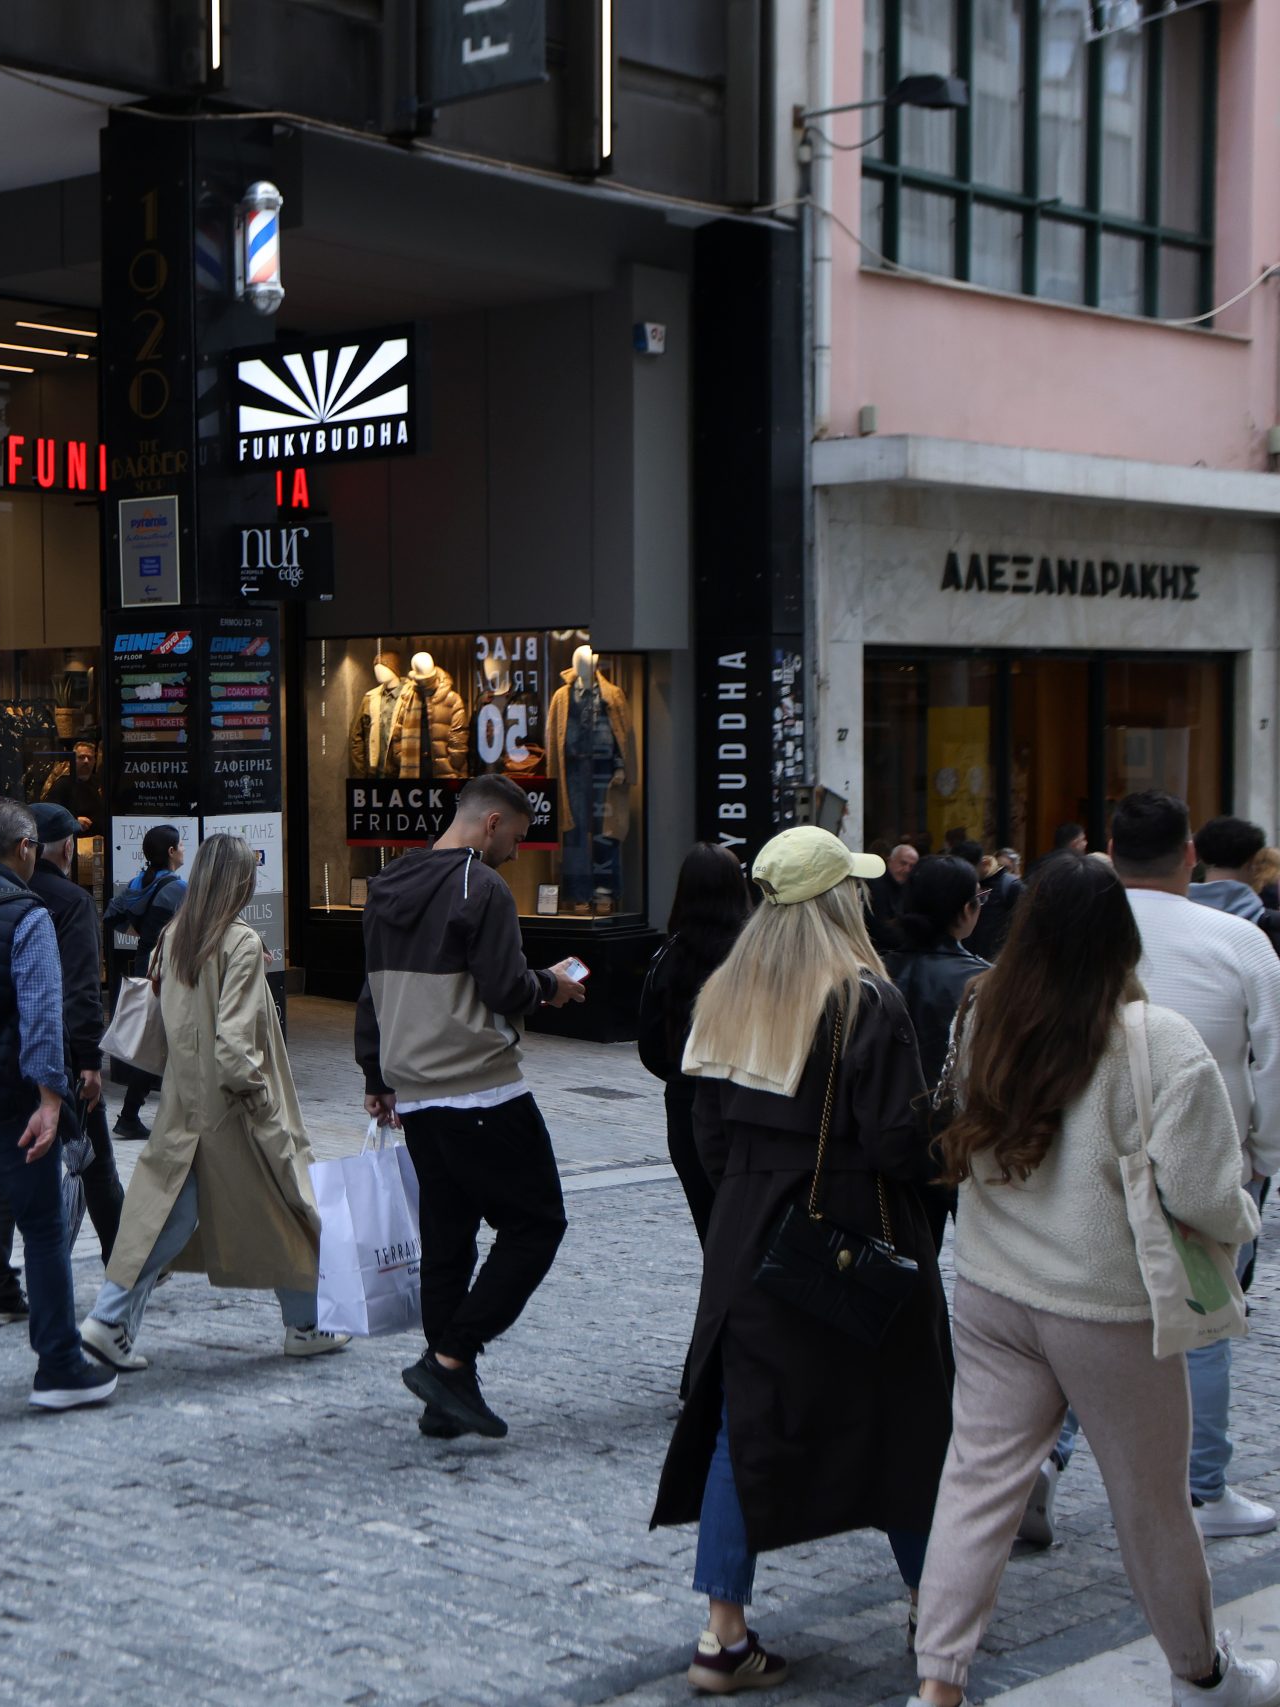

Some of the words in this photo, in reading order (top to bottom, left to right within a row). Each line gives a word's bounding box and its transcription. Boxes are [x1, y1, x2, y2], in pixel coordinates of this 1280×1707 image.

[238, 420, 409, 462] FUNKYBUDDHA
[240, 527, 310, 568] nur
[278, 565, 304, 588] edge
[940, 551, 1200, 600] ΑΛΕΞΑΝΔΡΑΚΗΣ
[114, 632, 167, 652] GINIS
[227, 687, 249, 697] COACH
[250, 687, 269, 696] TRIPS
[155, 718, 185, 727] TICKETS
[124, 761, 189, 774] ΖΑΦΕΙΡΗΣ
[214, 759, 273, 773] ΖΑΦΕΙΡΗΣ
[134, 780, 178, 789] ΥΦΑΣΜΑΤΑ
[353, 788, 443, 808] BLACK
[353, 813, 443, 832] FRIDAY
